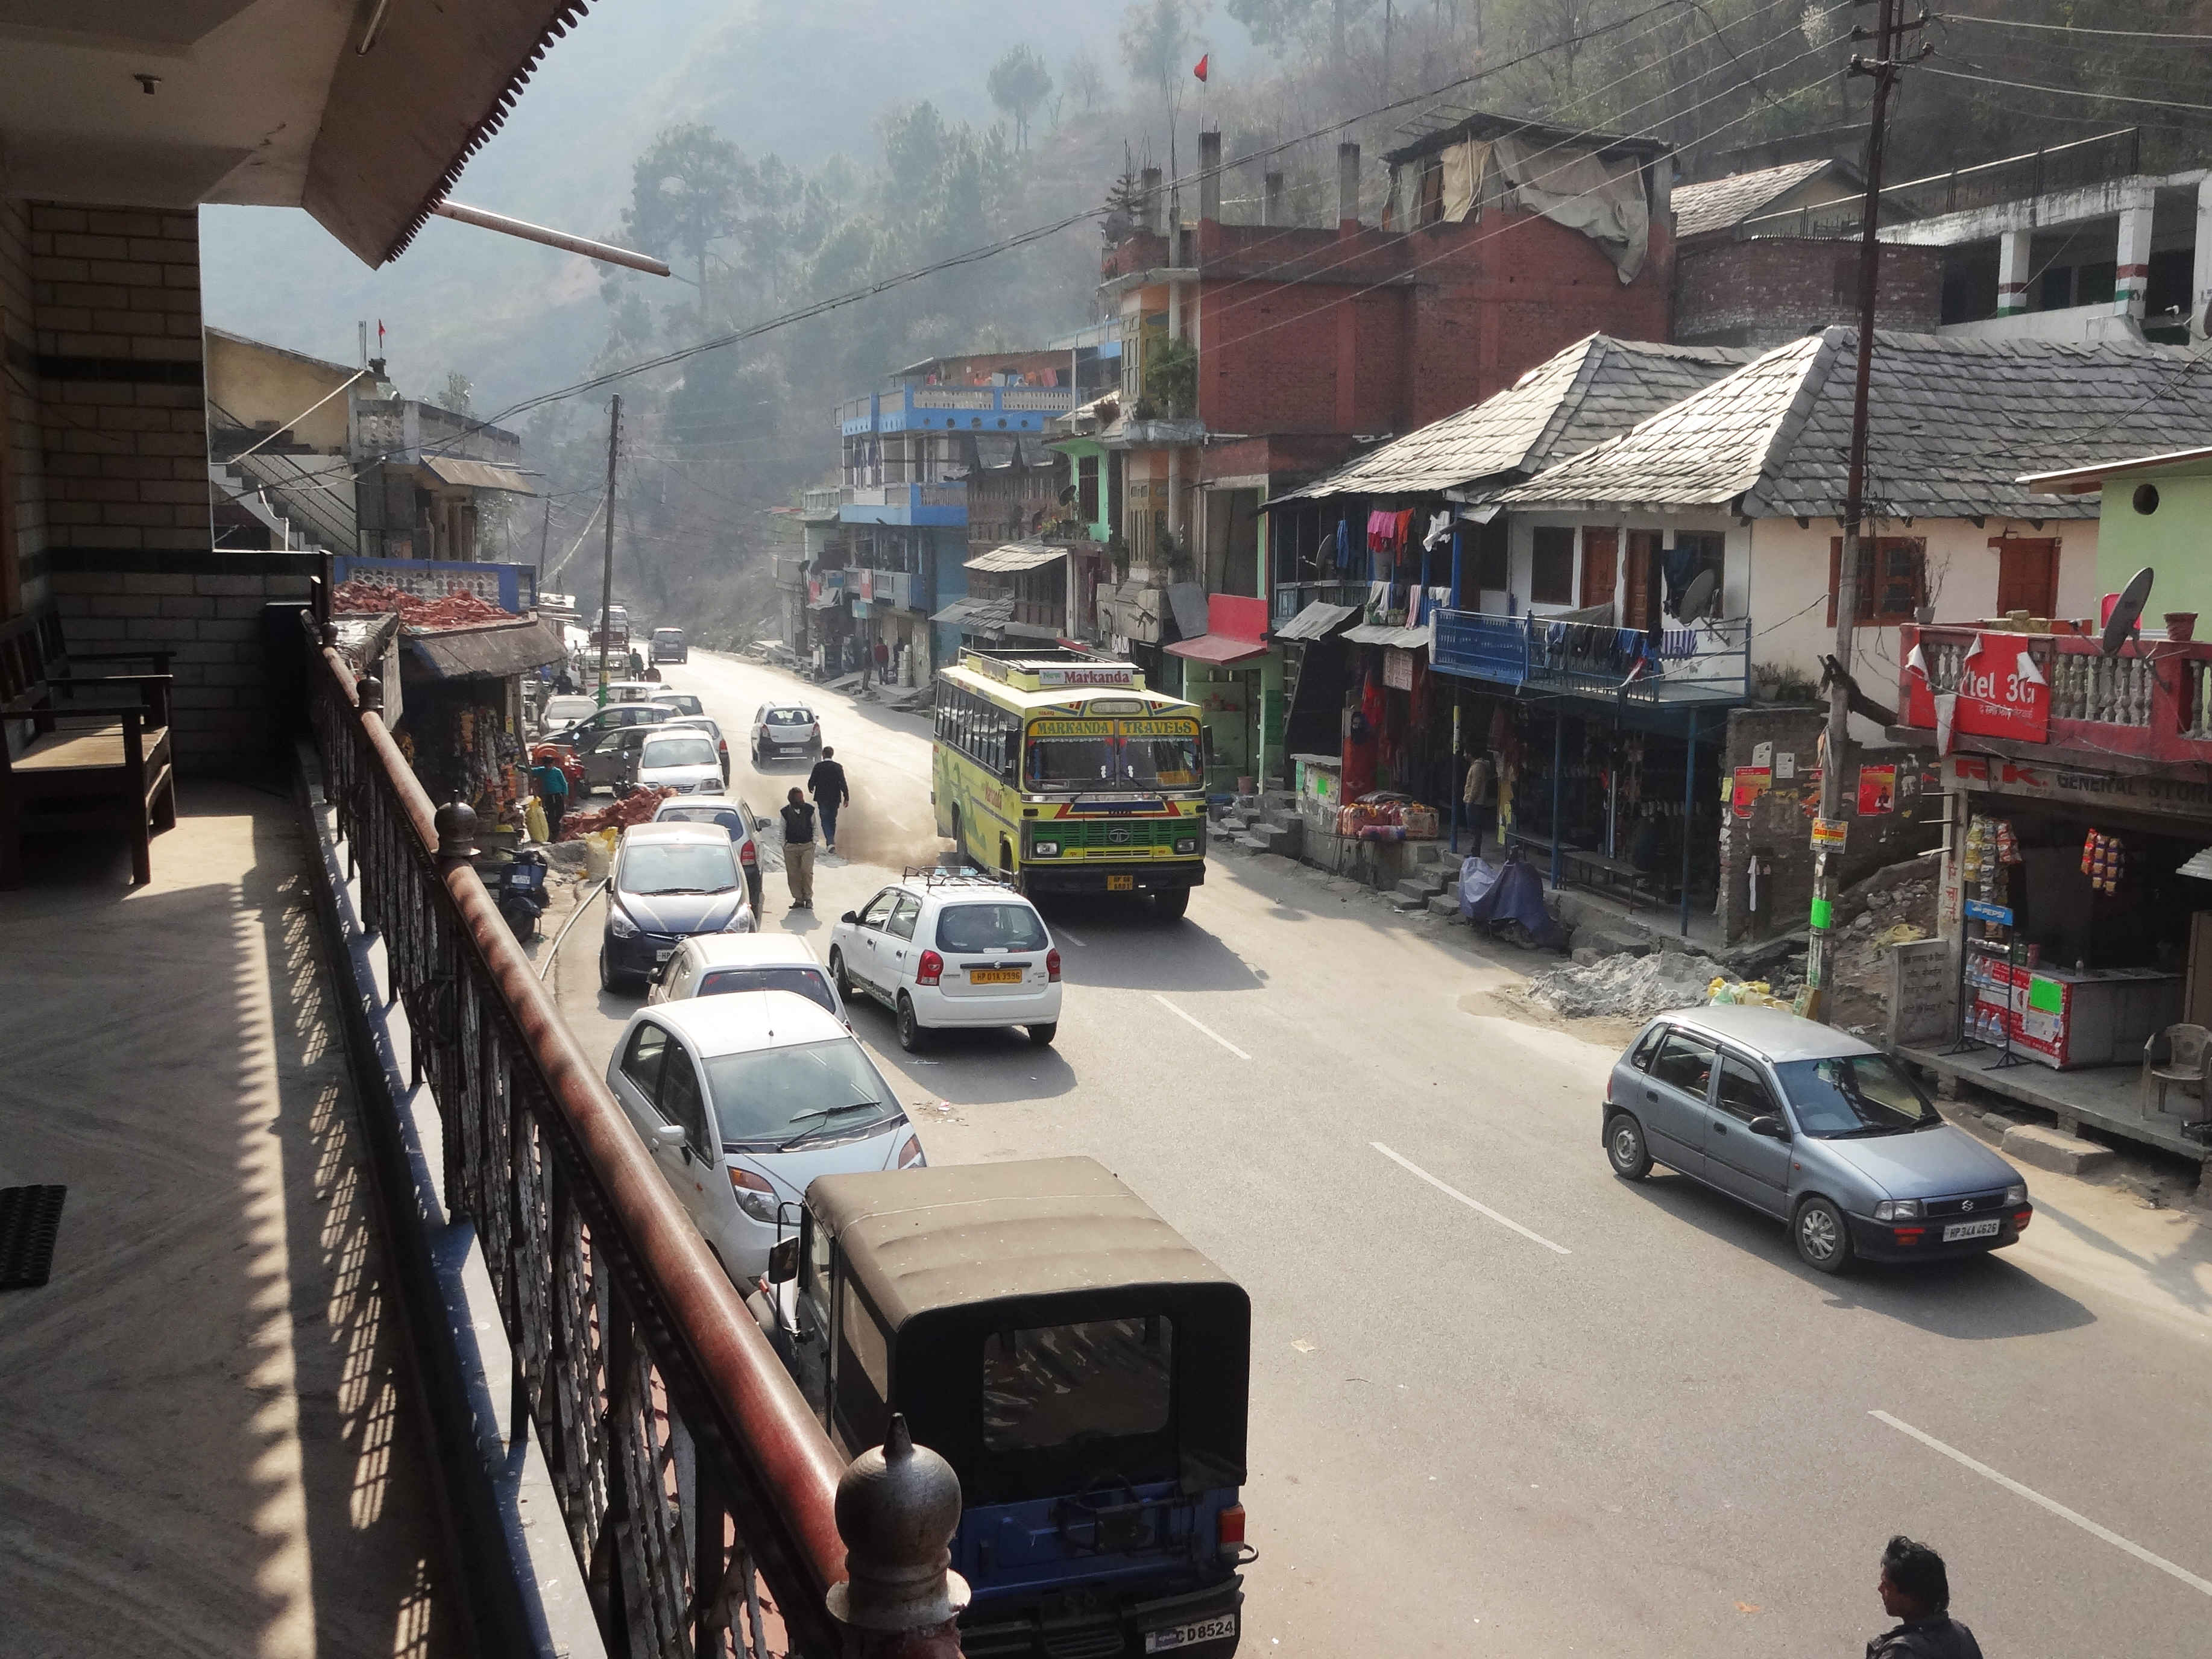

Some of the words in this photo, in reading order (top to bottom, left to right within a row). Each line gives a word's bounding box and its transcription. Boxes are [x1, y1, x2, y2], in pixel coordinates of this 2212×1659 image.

[1065, 670, 1130, 684] Markanda
[1037, 722, 1109, 735] MARKANDA
[1123, 722, 1192, 735] TRAVELS
